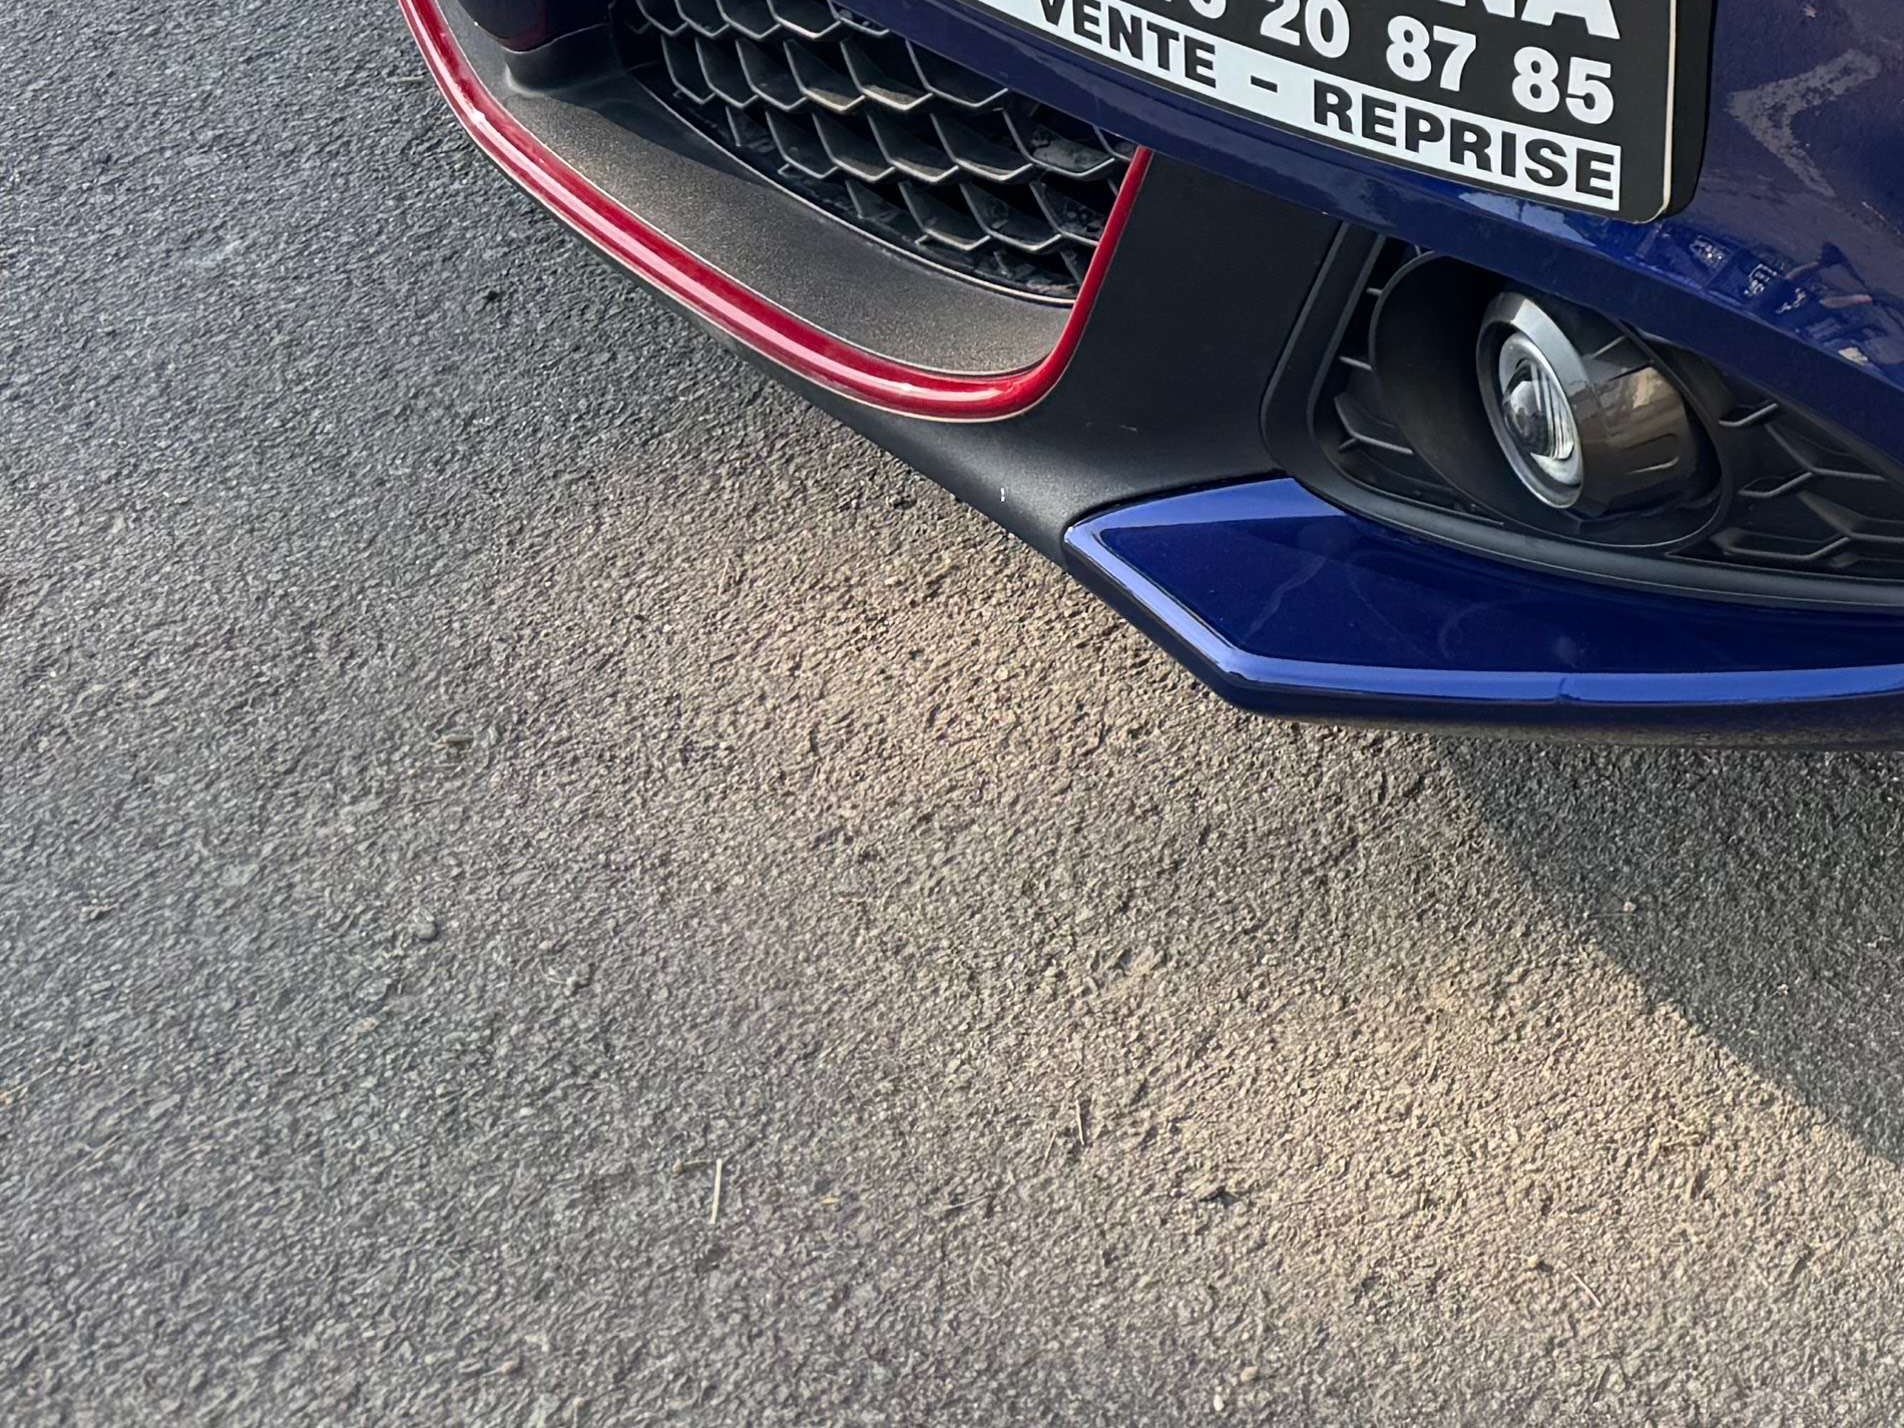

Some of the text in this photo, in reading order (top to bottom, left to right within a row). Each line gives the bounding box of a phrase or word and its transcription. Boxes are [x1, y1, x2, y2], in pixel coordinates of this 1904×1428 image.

[1386, 14, 1477, 93] 87
[1511, 46, 1615, 125] 85
[1313, 78, 1617, 200] REPRISE
